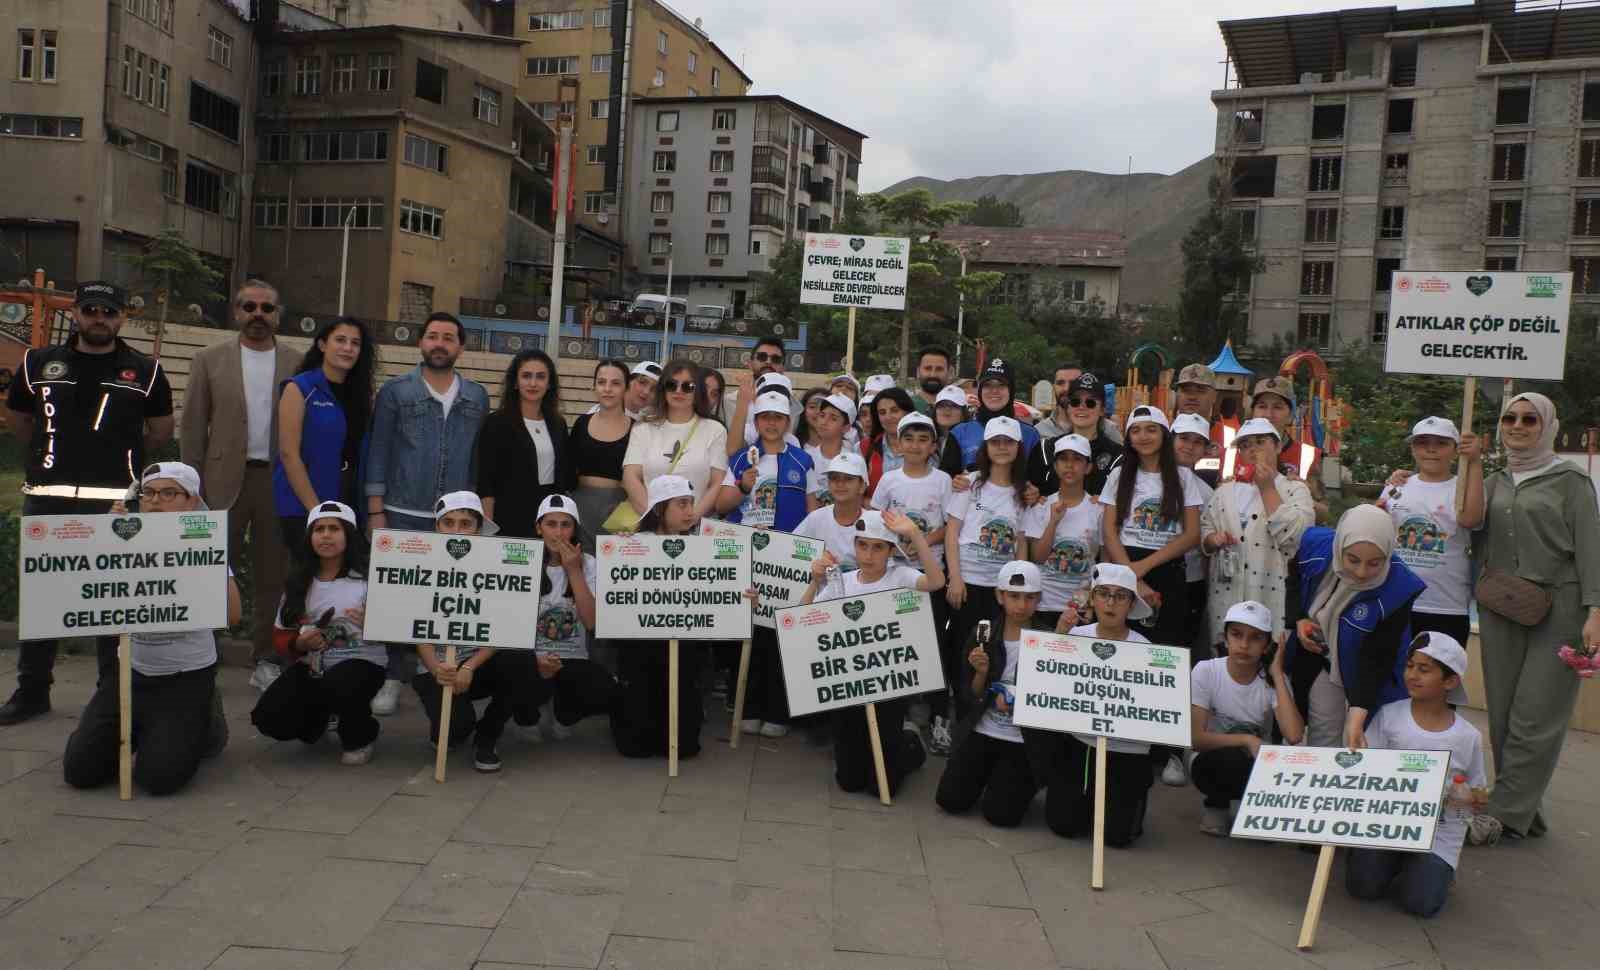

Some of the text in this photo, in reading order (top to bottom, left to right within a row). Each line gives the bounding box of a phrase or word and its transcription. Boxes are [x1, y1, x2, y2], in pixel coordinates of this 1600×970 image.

[807, 254, 904, 270] ÇEVRE; MİRAS DEĞİL
[803, 279, 905, 296] NESİLLERE DEVREDİLECEK
[832, 270, 876, 282] GELECEK
[832, 294, 873, 305] EMANET
[1395, 314, 1561, 335] ATIKLAR ÇÖP DEĞİL
[1421, 343, 1528, 361] GELECEKTİR.
[42, 386, 56, 469] POLİS
[24, 546, 225, 574] DÜNYA ORTAK EVİMİZ
[375, 565, 532, 594] TEMİZ BİR ÇEVRE
[610, 563, 737, 584] ÇÖP DEYİP GEÇME
[81, 579, 177, 600] SIFIR ATIK
[605, 587, 742, 608] GERİ DÖNÜŞÜMDEN
[63, 603, 189, 629] GELECEĞİMİZ
[432, 592, 481, 618] İÇİN
[412, 619, 490, 642] EL ELE
[638, 613, 715, 632] VAZGEÇME
[817, 621, 902, 652] SADECE
[810, 644, 919, 680] BİR SAYFA
[1035, 658, 1176, 688] SÜRDÜRÜLEBİLİR
[816, 669, 920, 704] DEMEYİN!
[1073, 681, 1135, 704] DÜŞÜN,
[1025, 692, 1182, 725] KÜRESEL HAREKET
[1091, 718, 1115, 733] ET.
[1272, 772, 1419, 793] 1-7 HAZİRAN
[1247, 790, 1437, 818] TÜRKİYE ÇEVRE HAFTASI
[1242, 814, 1422, 841] KUTLU OLSUN
